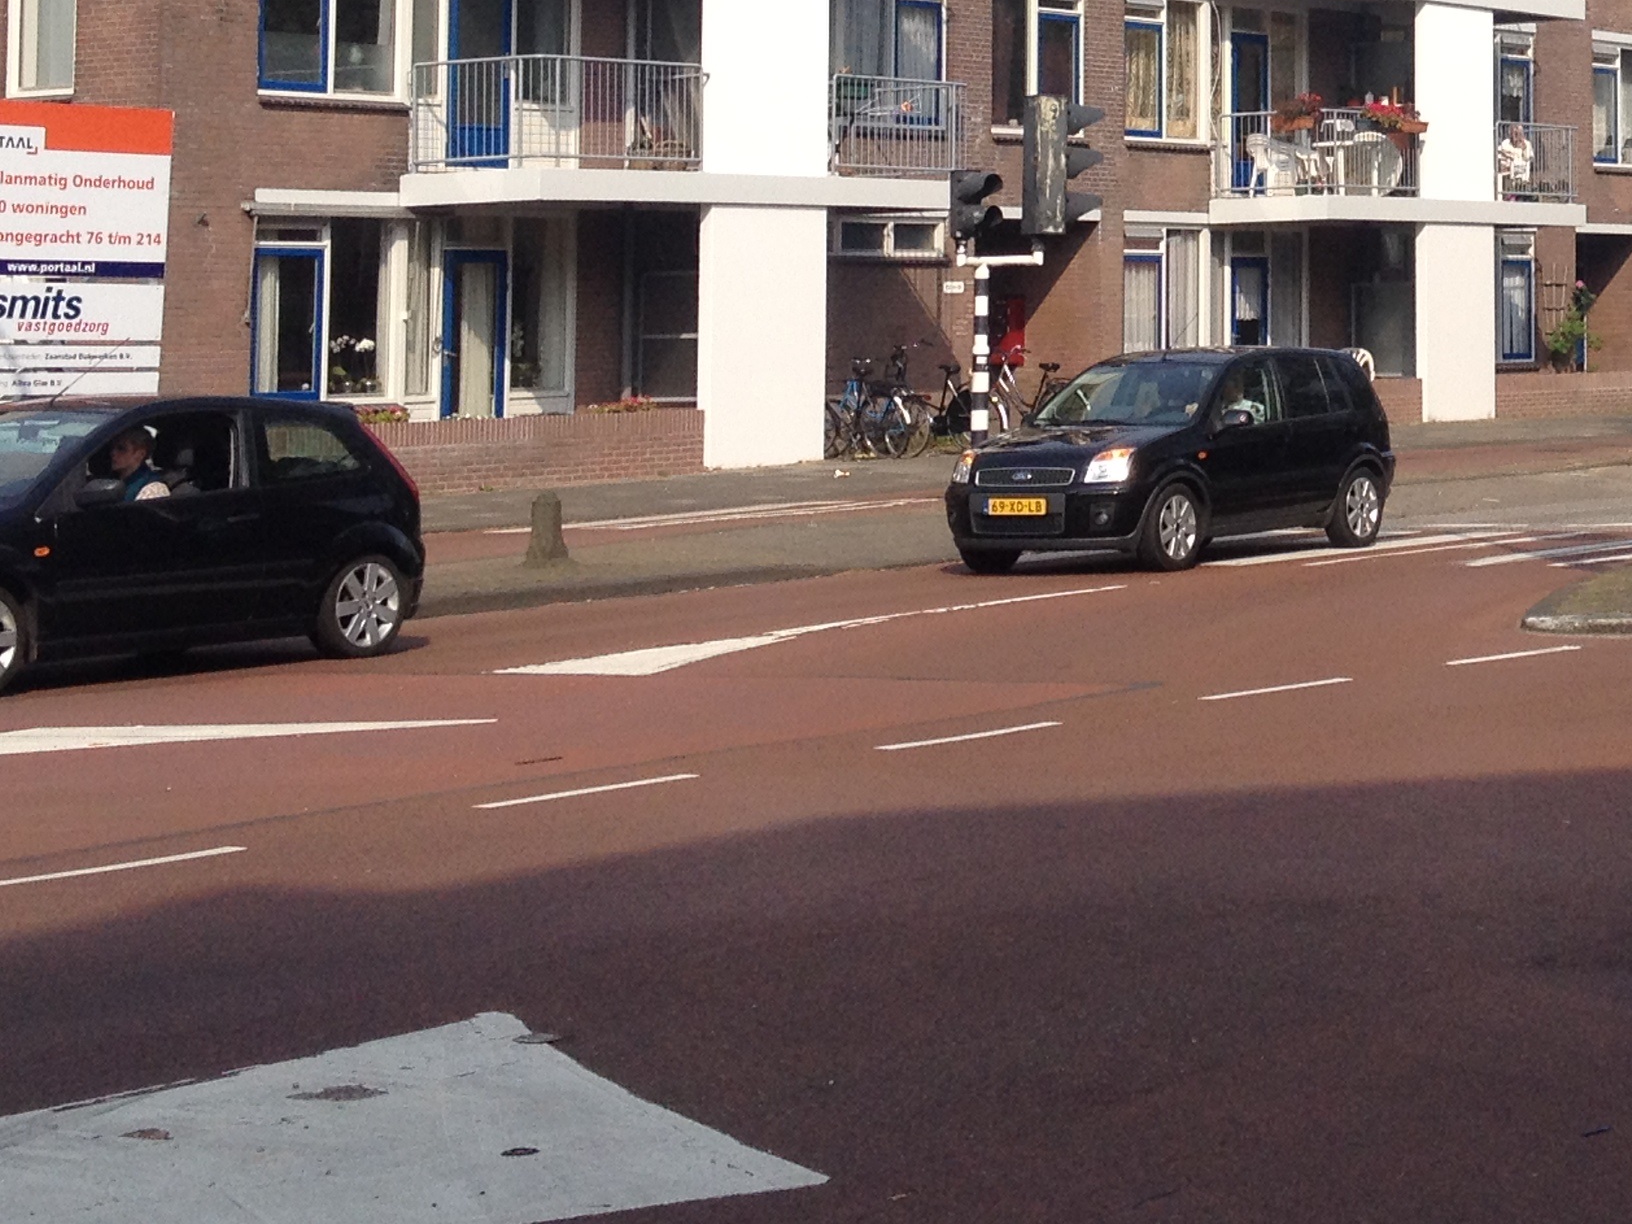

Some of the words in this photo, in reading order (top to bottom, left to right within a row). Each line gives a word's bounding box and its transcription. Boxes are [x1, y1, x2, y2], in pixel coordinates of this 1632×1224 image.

[72, 174, 155, 191] Onderhoud
[11, 201, 87, 219] woningen
[86, 231, 103, 245] 76
[107, 231, 132, 246] t/m
[136, 232, 161, 246] 214
[6, 262, 96, 274] www.portaal.nl
[17, 318, 110, 336] vastgoedzorg
[991, 500, 1042, 513] 69-XD-LB
